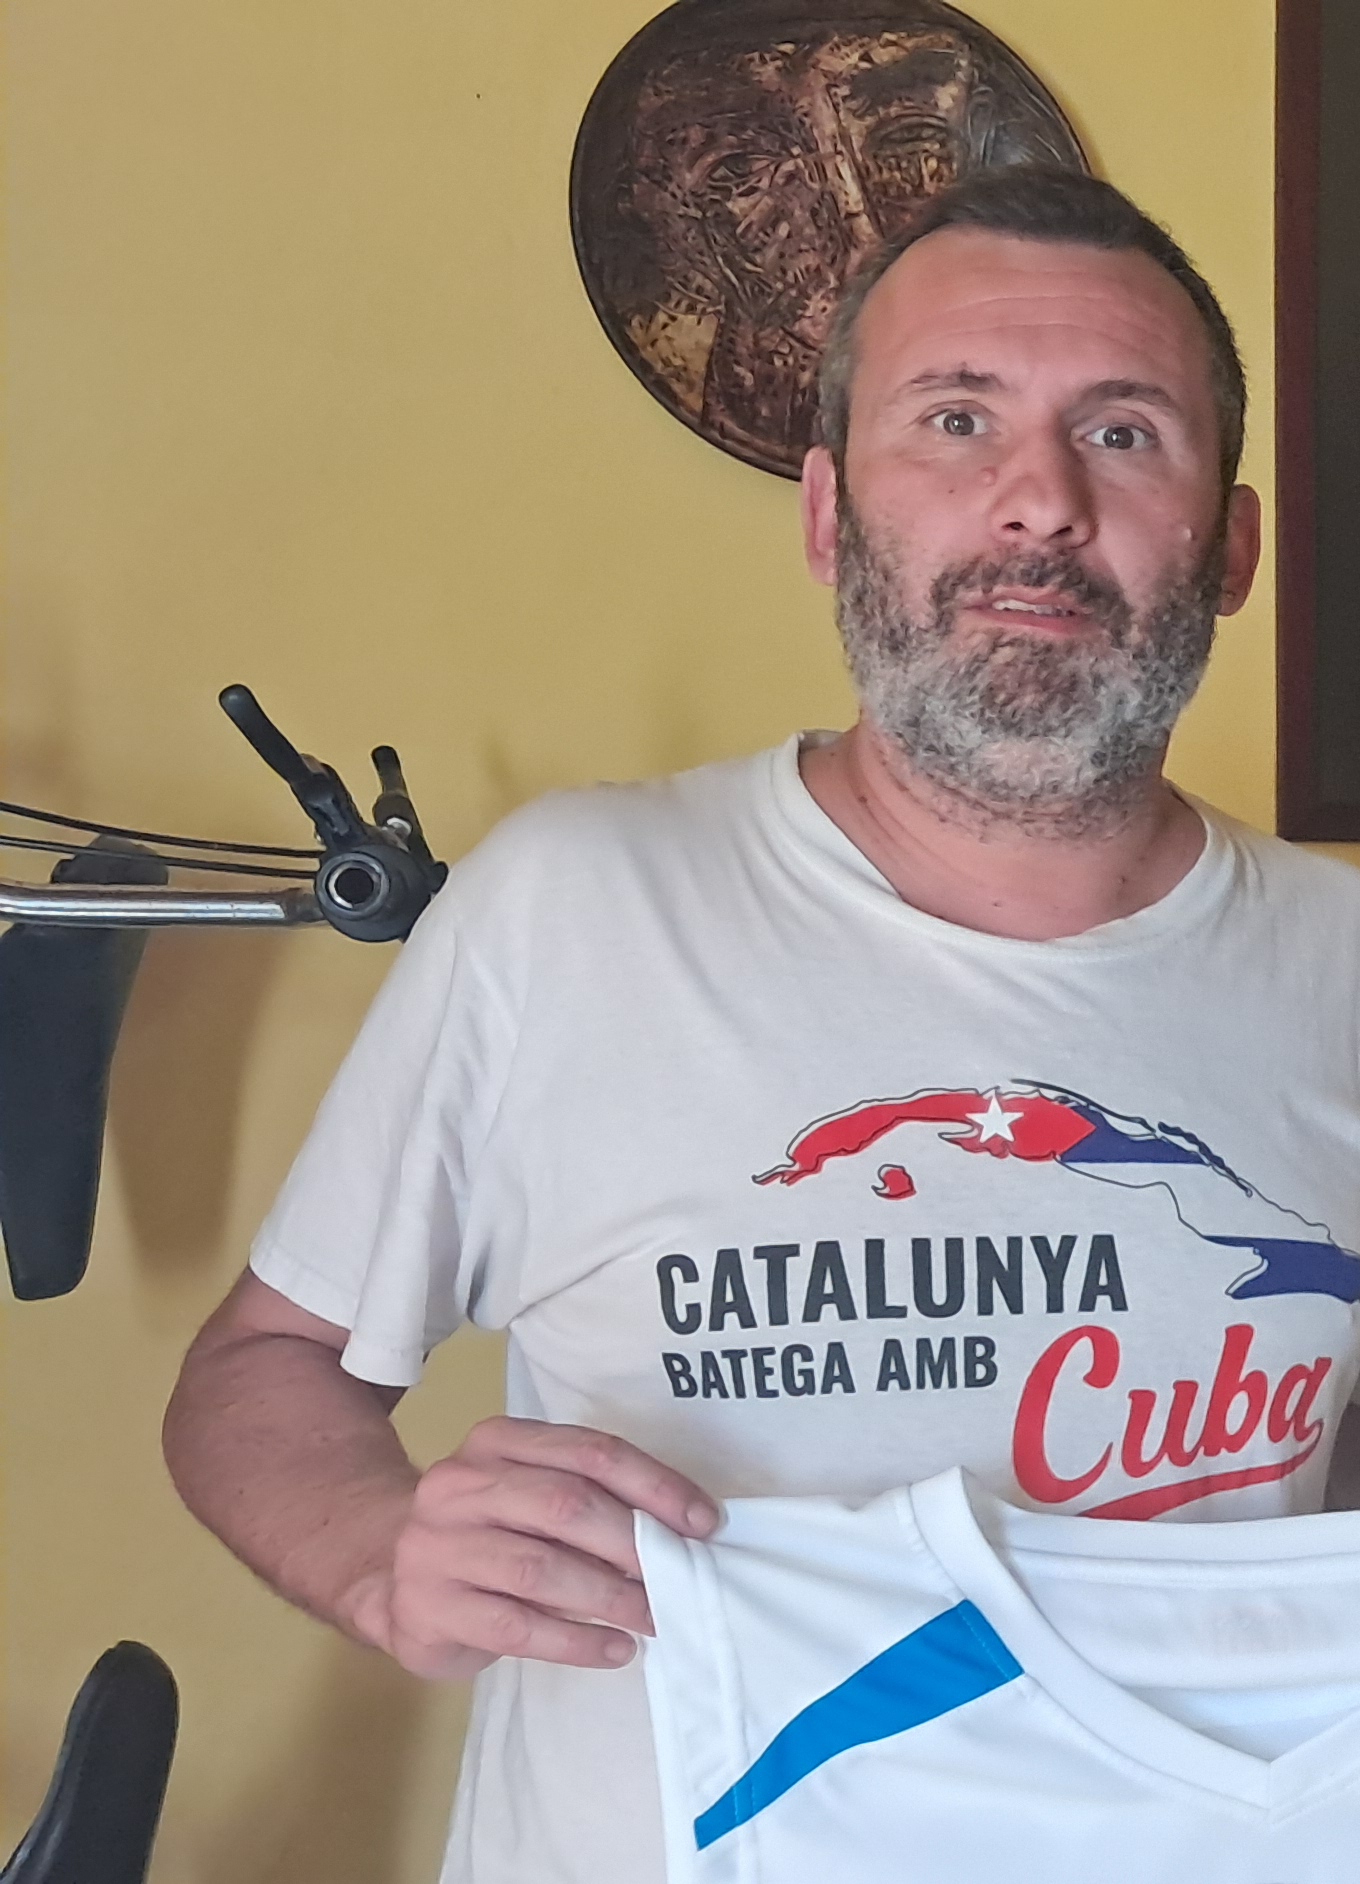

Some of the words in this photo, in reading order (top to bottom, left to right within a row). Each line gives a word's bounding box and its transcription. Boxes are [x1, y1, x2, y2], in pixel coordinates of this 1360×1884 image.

[656, 1234, 1129, 1335] CATALUNYA
[661, 1340, 857, 1399] BATEGA
[877, 1335, 998, 1392] AMB
[1012, 1323, 1332, 1504] Cuba
